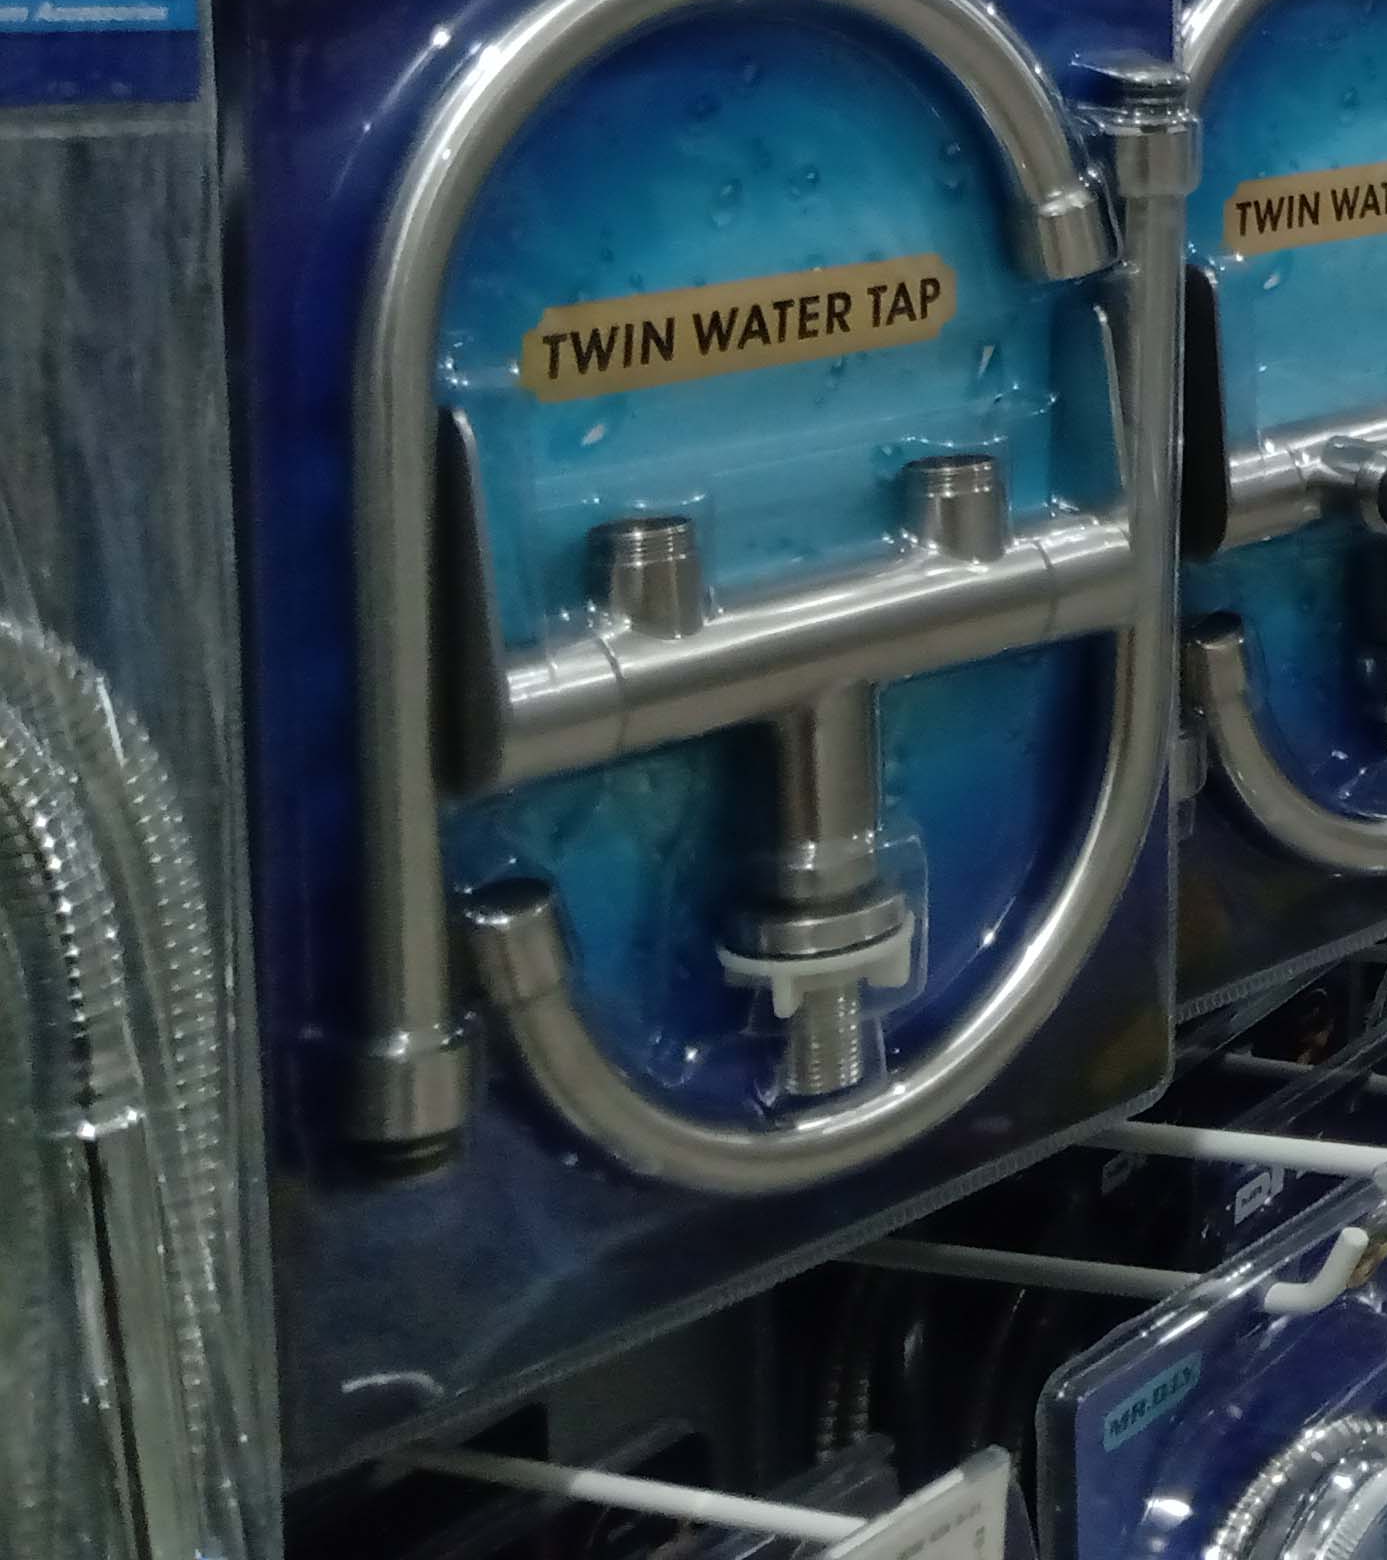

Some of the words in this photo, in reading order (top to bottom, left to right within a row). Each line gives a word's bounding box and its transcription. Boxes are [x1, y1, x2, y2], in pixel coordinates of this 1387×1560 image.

[1235, 192, 1320, 237] TWIN
[542, 317, 676, 380] TWIN
[692, 291, 853, 356] WATER
[866, 277, 942, 328] TAP
